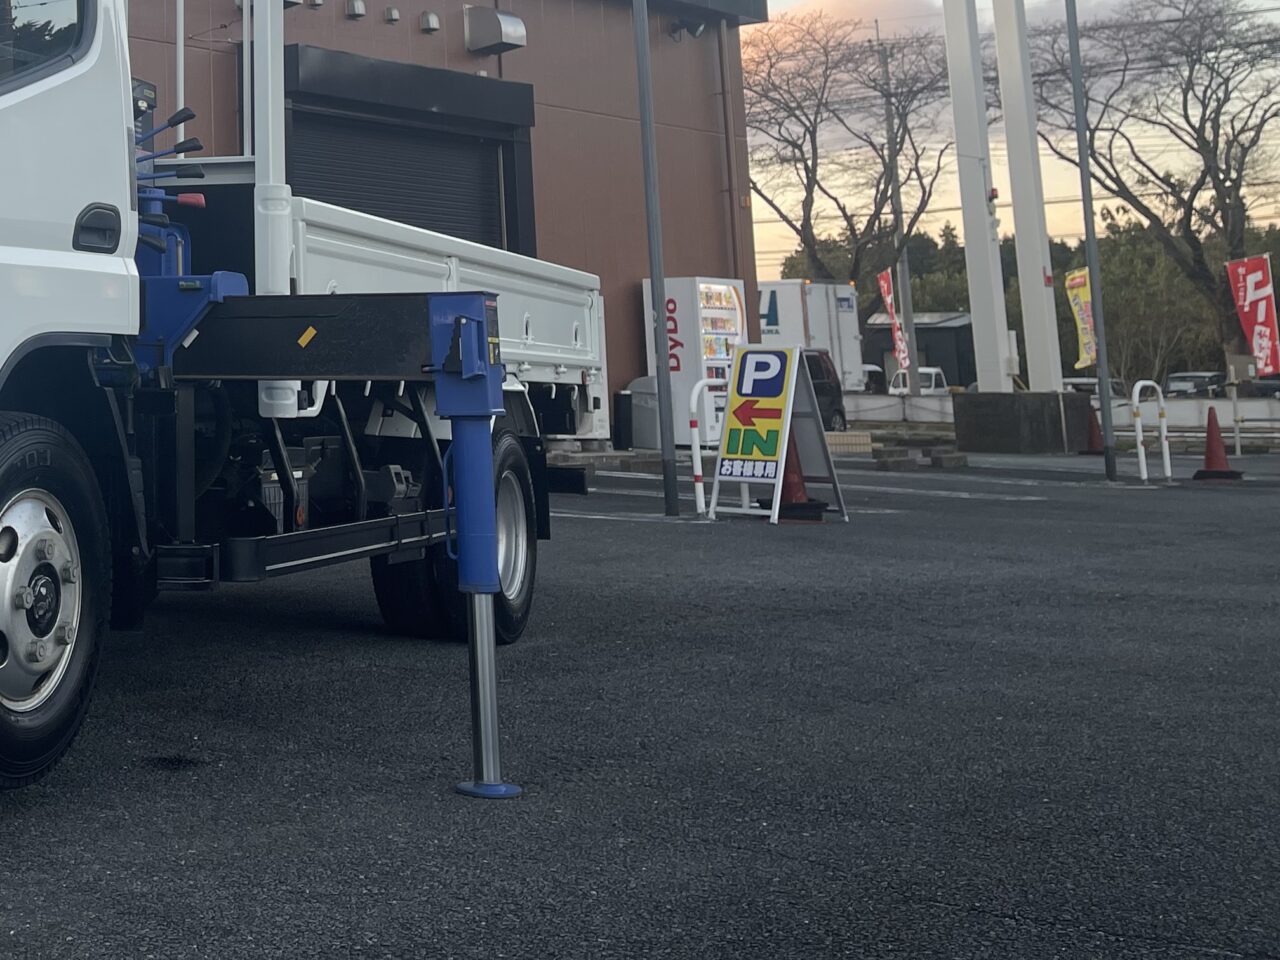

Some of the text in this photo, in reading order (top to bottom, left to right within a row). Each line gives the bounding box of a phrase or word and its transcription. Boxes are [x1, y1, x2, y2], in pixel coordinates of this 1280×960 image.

[741, 353, 782, 395] P
[726, 428, 780, 457] IN
[721, 459, 777, 478] お客様専用
